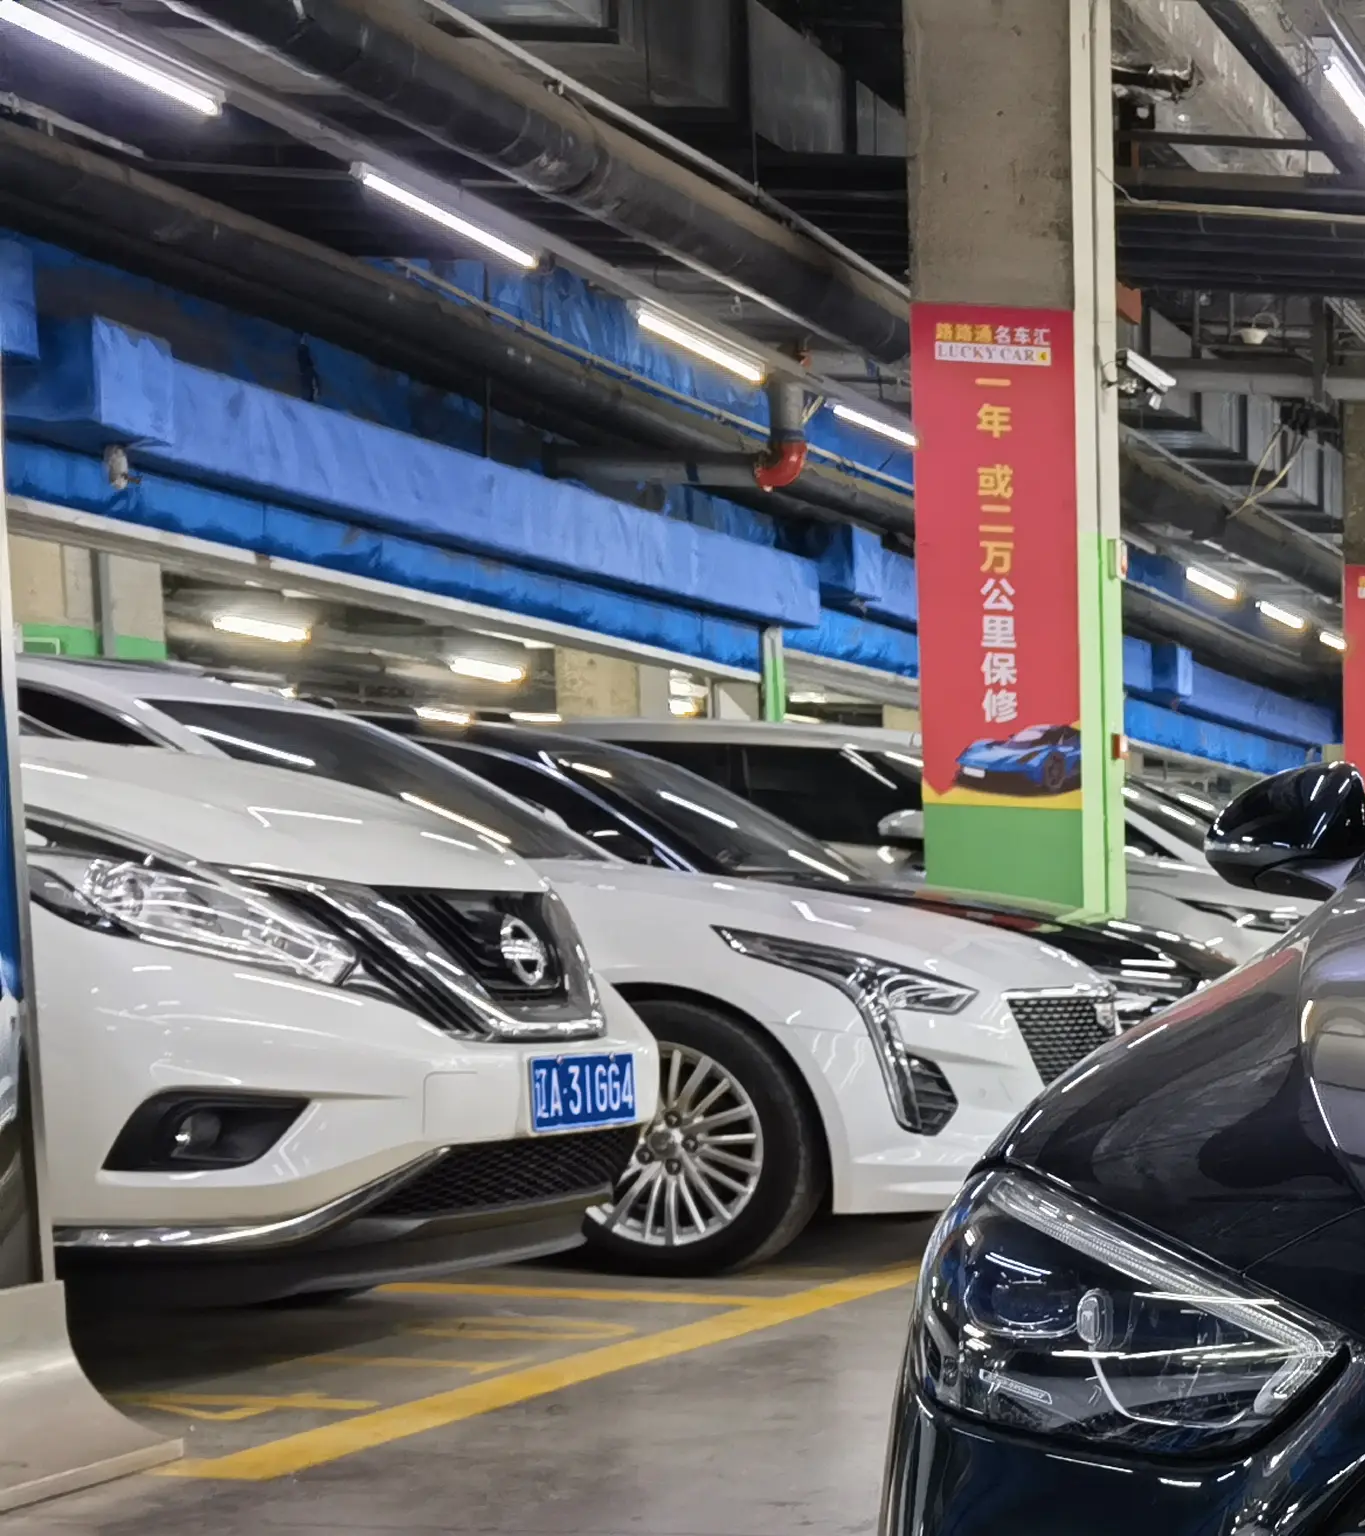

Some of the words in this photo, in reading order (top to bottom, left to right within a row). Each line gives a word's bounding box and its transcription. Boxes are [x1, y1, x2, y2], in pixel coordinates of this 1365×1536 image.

[937, 344, 998, 361] LUCKY
[999, 348, 1036, 362] CAR
[975, 378, 1013, 440] 一年
[976, 464, 1018, 724] 或二万公里保修
